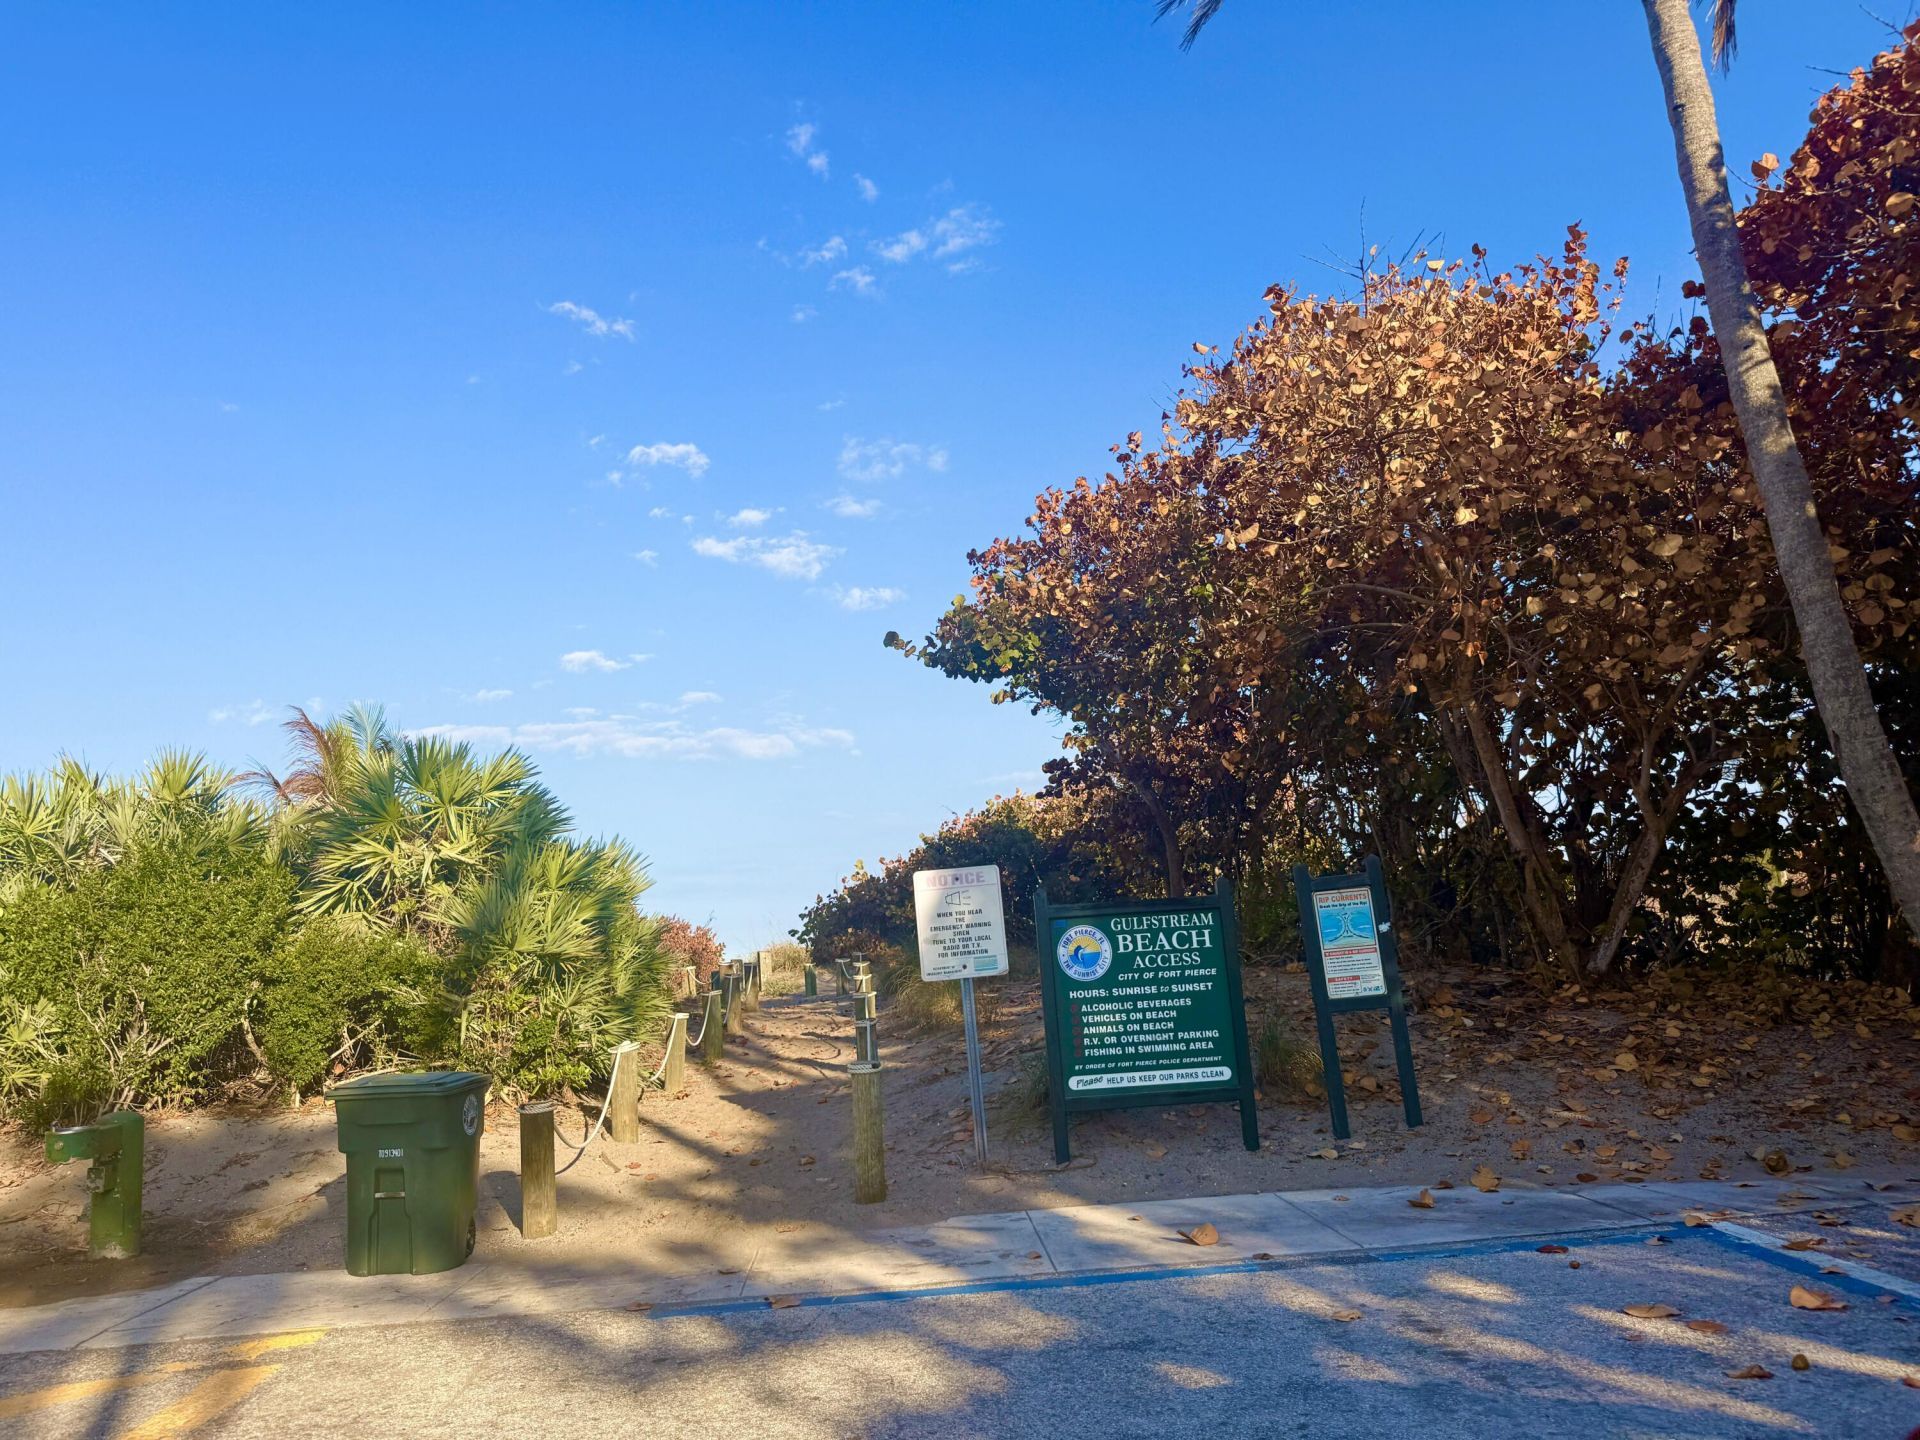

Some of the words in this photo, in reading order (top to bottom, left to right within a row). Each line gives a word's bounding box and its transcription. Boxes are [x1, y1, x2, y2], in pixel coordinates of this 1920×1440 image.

[926, 871, 986, 887] NOTICE
[1332, 893, 1366, 901] CURRENTS
[1111, 913, 1214, 931] GULFSTREAM
[1062, 934, 1073, 948] FORT
[1098, 936, 1105, 944] FL
[1116, 929, 1213, 953] BEACH
[951, 949, 988, 957] INFORMATION
[1134, 952, 1200, 968] ACCESS
[1064, 960, 1073, 971] THE
[1074, 969, 1098, 977] SUNRISE
[1100, 956, 1108, 969] CITY
[1185, 968, 1216, 976] PIERCE
[1070, 989, 1109, 999] HOURS:
[1112, 986, 1158, 996] SUNRISE
[1172, 982, 1213, 992] SUNSET
[1082, 1002, 1133, 1012] ALCOHOLIC
[1137, 998, 1192, 1008] BEVERAGES
[1082, 1013, 1127, 1023] VEHICLES
[1146, 1010, 1176, 1019] BEACH
[1084, 1024, 1124, 1034] ANIMALS
[1143, 1022, 1174, 1030] BEACH
[1121, 1033, 1174, 1043] OVERNIGHT
[1178, 1030, 1219, 1039] PARKING
[1085, 1048, 1122, 1056] FISHING
[1138, 1043, 1186, 1053] SWIMMING
[1190, 1041, 1214, 1050] AREA
[1076, 1076, 1104, 1088] Please
